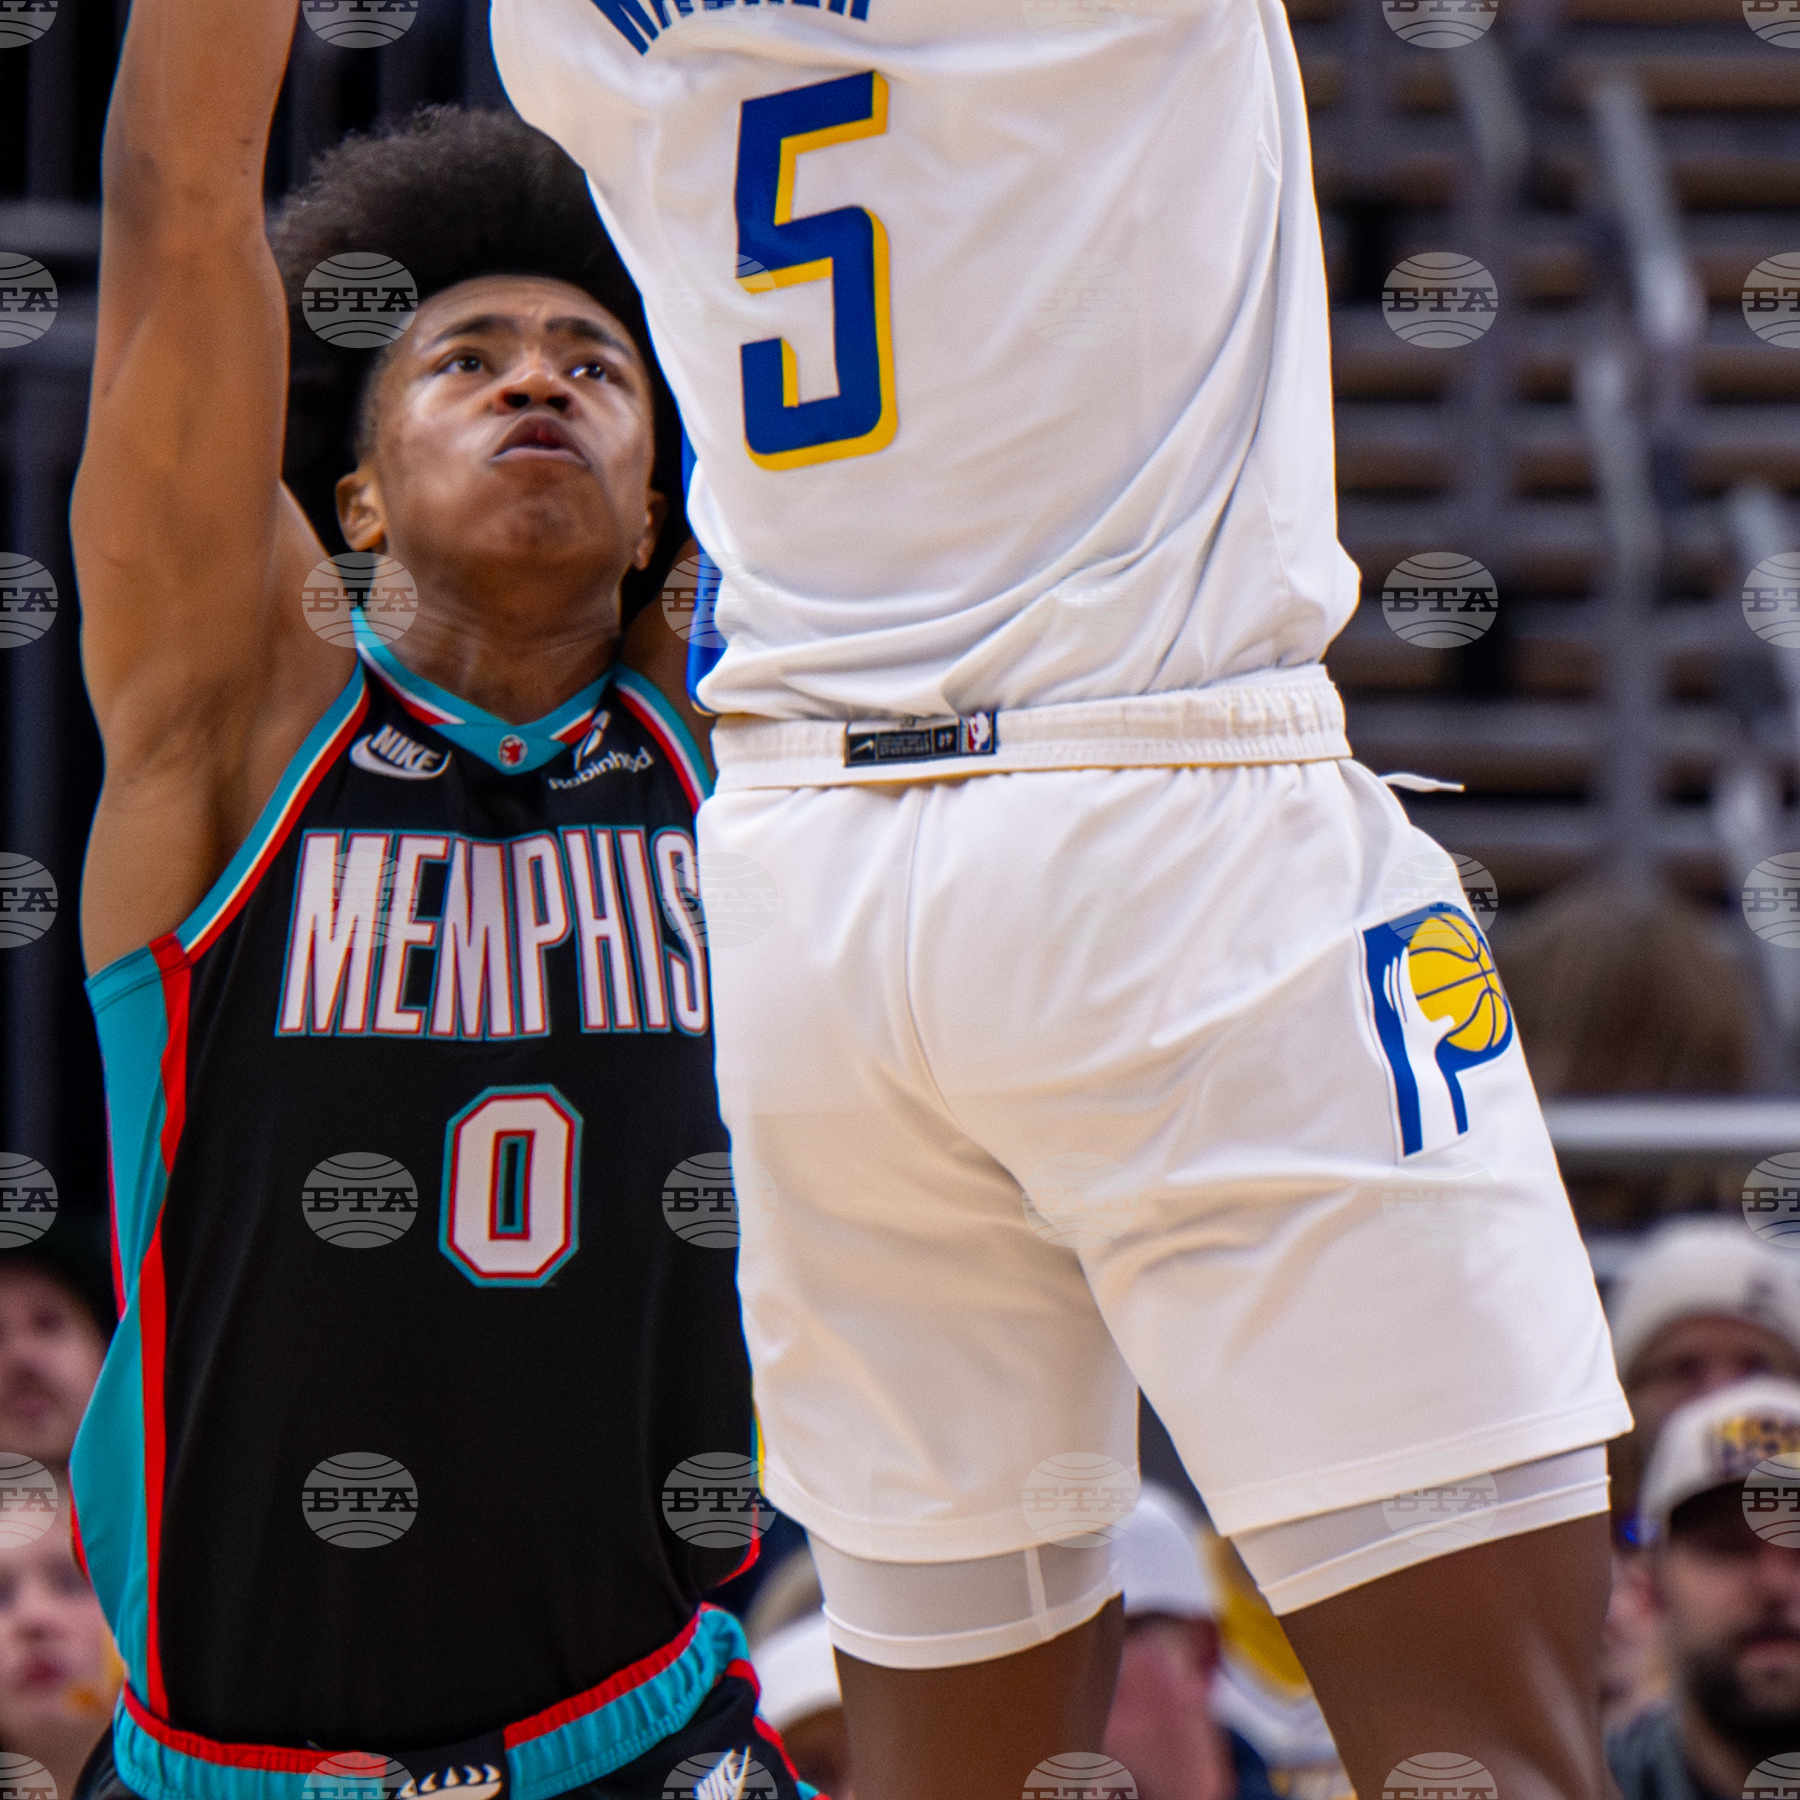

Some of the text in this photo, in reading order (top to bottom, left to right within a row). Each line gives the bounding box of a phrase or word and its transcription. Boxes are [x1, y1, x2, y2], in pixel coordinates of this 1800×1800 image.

[734, 69, 898, 472] 5
[369, 722, 442, 772] NIKE
[275, 825, 708, 1041] MEMPHIS
[438, 1083, 583, 1288] 0
